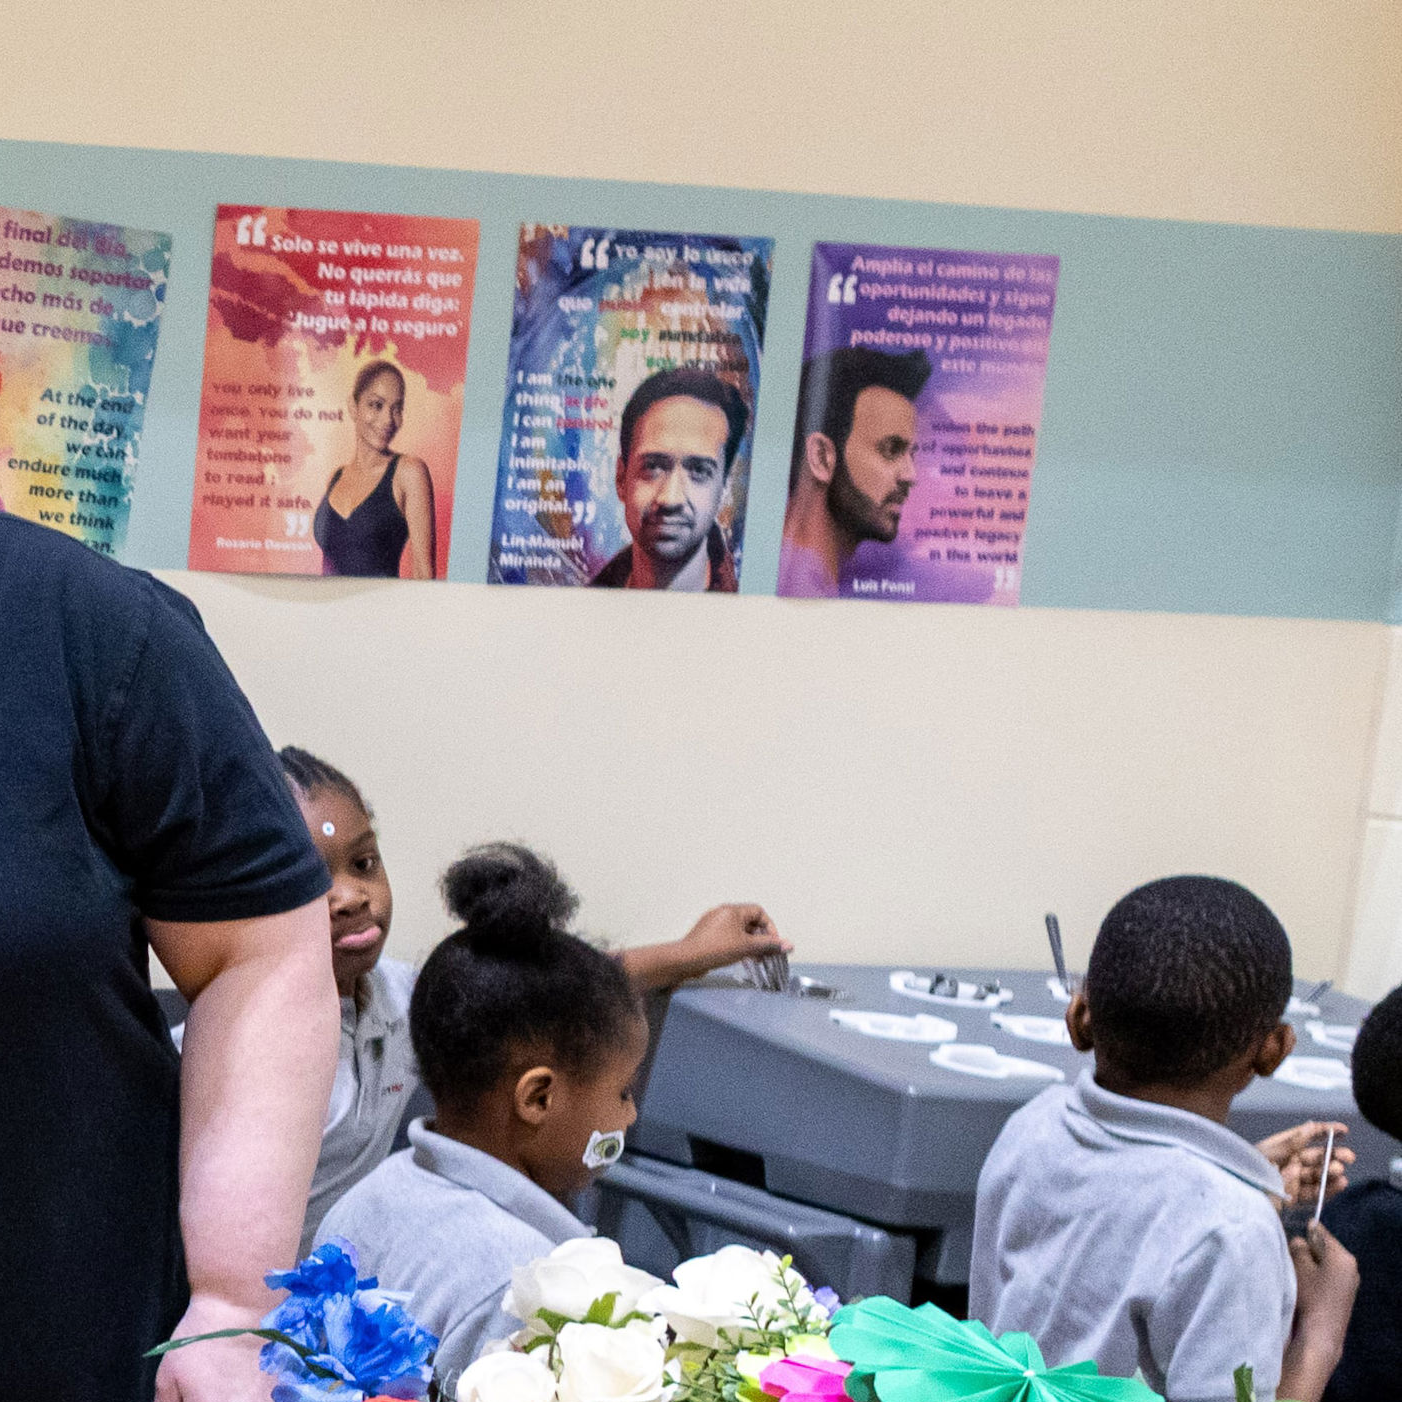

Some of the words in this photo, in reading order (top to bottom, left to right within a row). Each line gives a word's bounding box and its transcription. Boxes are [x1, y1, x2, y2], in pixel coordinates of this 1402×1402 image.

[4, 221, 52, 244] final
[56, 228, 88, 249] del
[271, 235, 313, 253] Solo
[318, 239, 338, 254] se
[343, 239, 382, 256] vive
[386, 244, 423, 260] una
[70, 266, 154, 290] soportar
[318, 262, 345, 279] No
[426, 272, 462, 289] que
[42, 292, 82, 311] más
[89, 298, 114, 316] de
[325, 290, 345, 305] tu
[355, 319, 367, 332] a
[371, 316, 389, 333] lo
[527, 373, 552, 385] am
[247, 384, 281, 398] only
[287, 384, 314, 397] live
[40, 388, 61, 404] At
[68, 393, 95, 408] the
[100, 399, 135, 414] end
[37, 413, 56, 426] of
[60, 416, 89, 432] the
[293, 408, 313, 420] do
[318, 409, 343, 421] not
[522, 415, 552, 428] can
[67, 442, 91, 455] we
[96, 448, 127, 460] can
[521, 436, 546, 448] am
[8, 458, 71, 476] endure
[75, 466, 122, 483] much
[205, 471, 221, 483] to
[516, 479, 540, 491] am
[545, 479, 566, 491] an
[29, 484, 74, 500] more
[79, 491, 118, 507] than
[39, 509, 64, 522] we
[70, 512, 114, 530] think
[499, 553, 561, 568] Miranda
